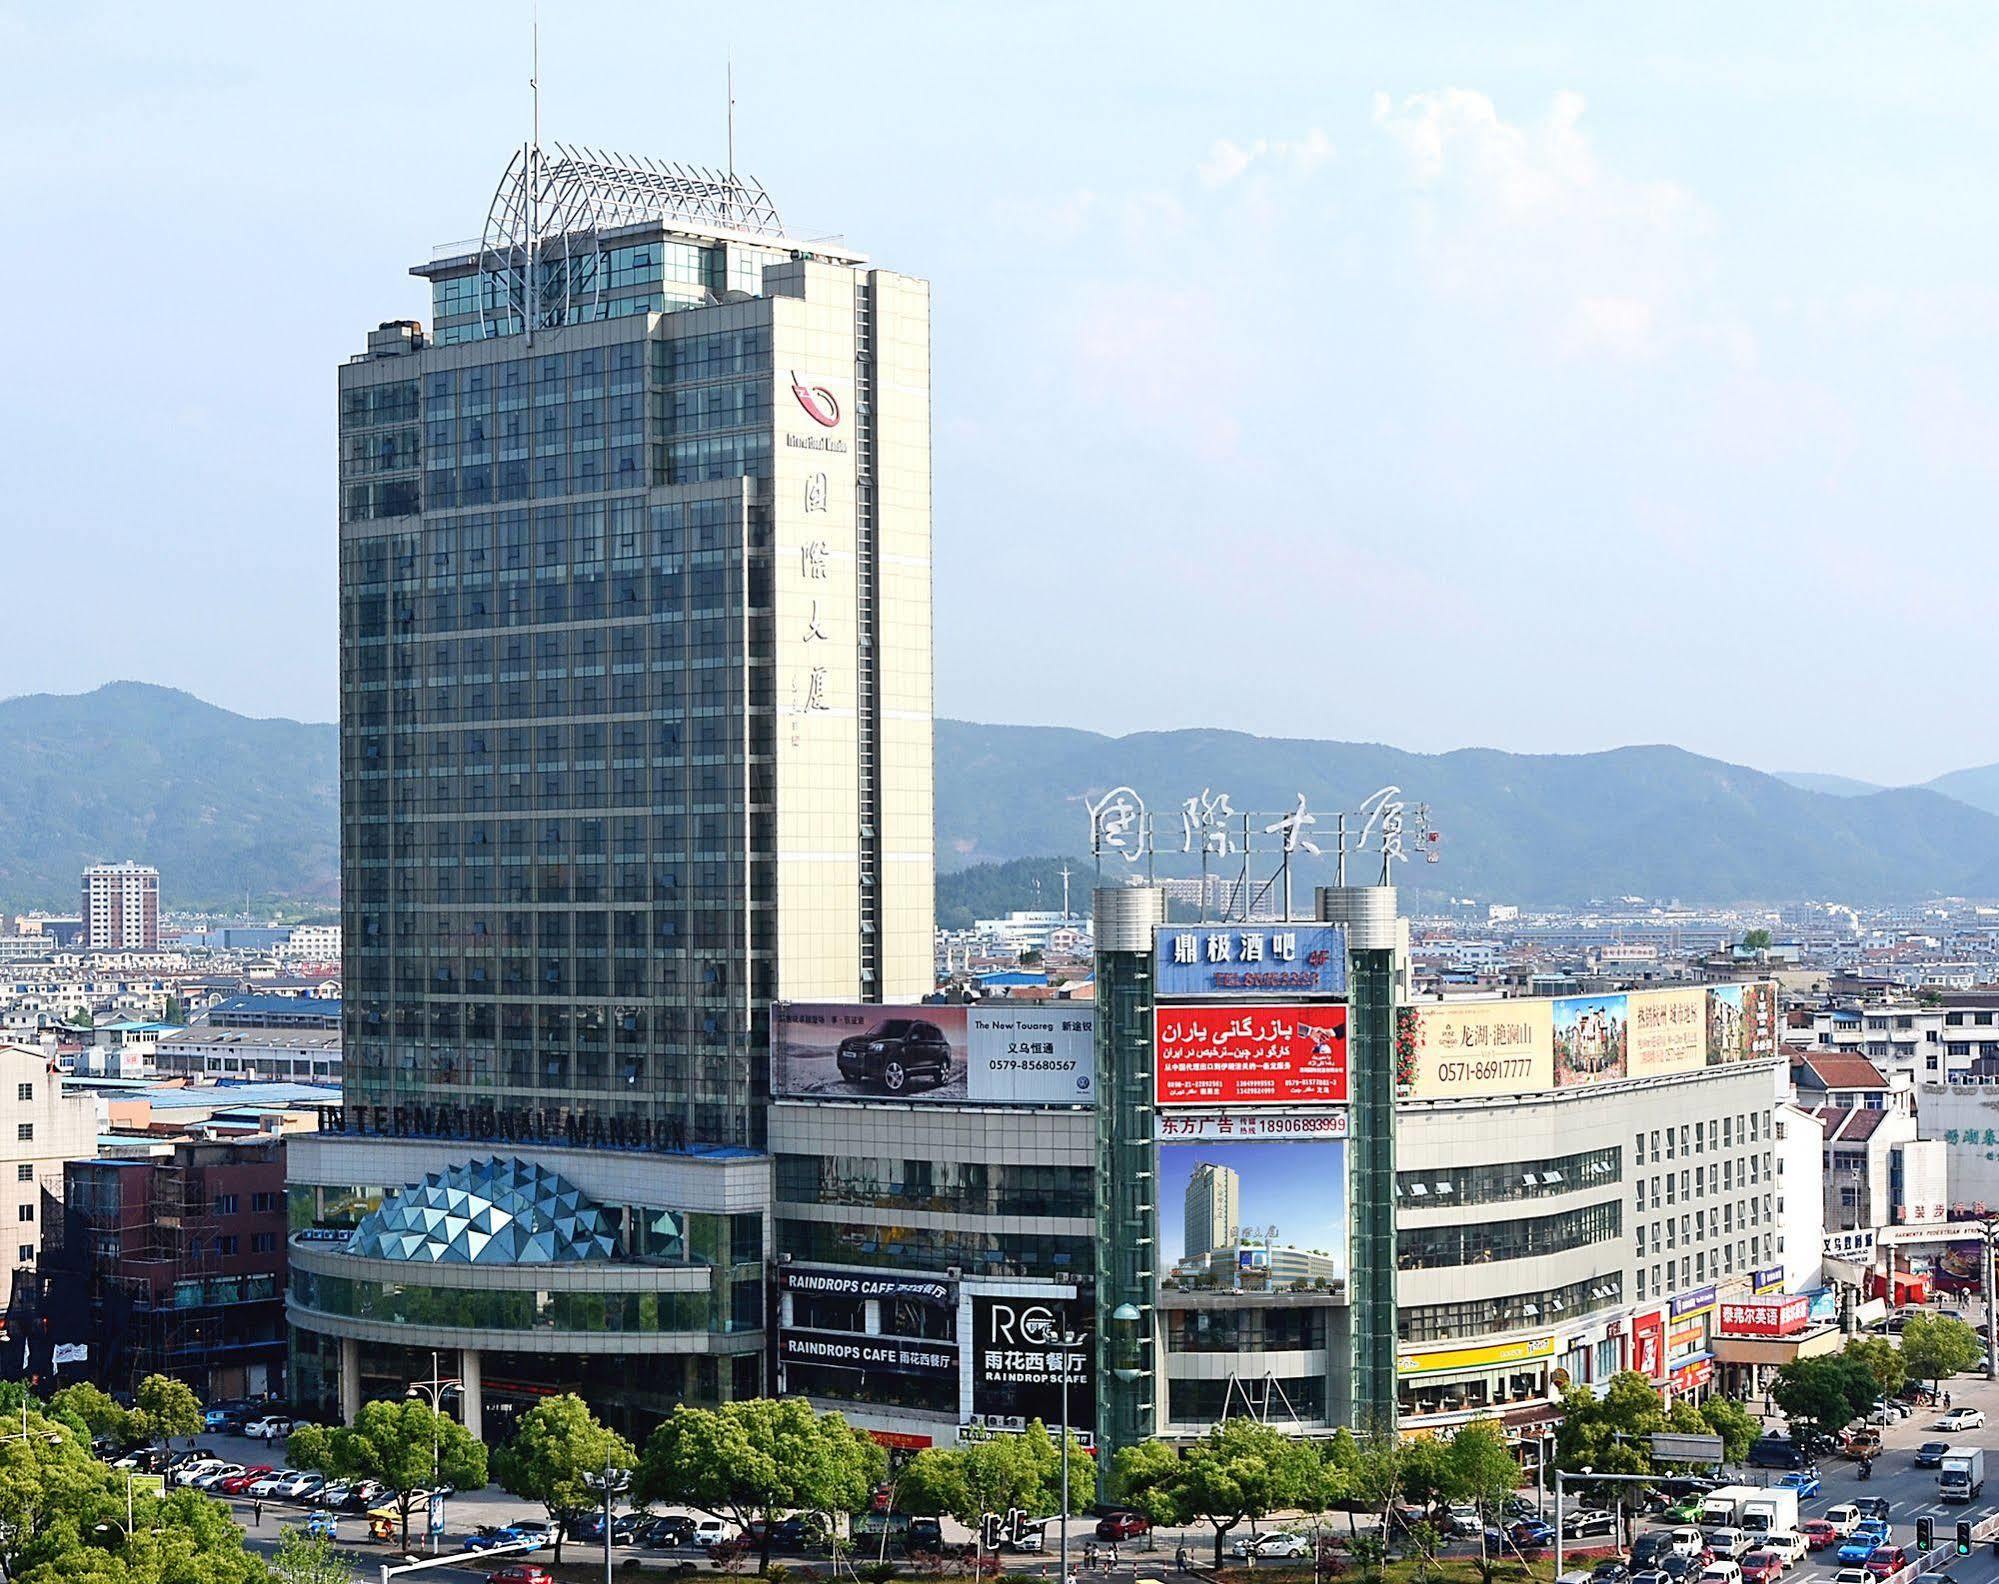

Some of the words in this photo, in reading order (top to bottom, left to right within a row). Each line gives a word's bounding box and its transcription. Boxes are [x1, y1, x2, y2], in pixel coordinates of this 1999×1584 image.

[1174, 933, 1296, 963] 鼎极酒吧
[975, 1021, 989, 1029] The
[992, 1021, 1014, 1029] New
[1016, 1022, 1054, 1031] Touareg
[1062, 1021, 1092, 1032] 新途锐
[1212, 1016, 1293, 1044] بازرگانی
[1007, 1043, 1054, 1054] 义乌恒通
[989, 1060, 1077, 1070] 0579-85680567
[1438, 1059, 1532, 1082] 0571-86917777
[317, 1104, 558, 1145] INTERNATIONAL
[566, 1113, 688, 1152] MANSION
[1161, 1116, 1234, 1135] 东方广告
[1260, 1118, 1346, 1133] 18906893999
[788, 1275, 859, 1292] RAINDROPS
[788, 1339, 860, 1359] RAINDROPS
[862, 1348, 897, 1362] CAFE
[899, 1350, 951, 1368] 雨花西餐厅
[985, 1350, 1087, 1371] 雨花西餐厅
